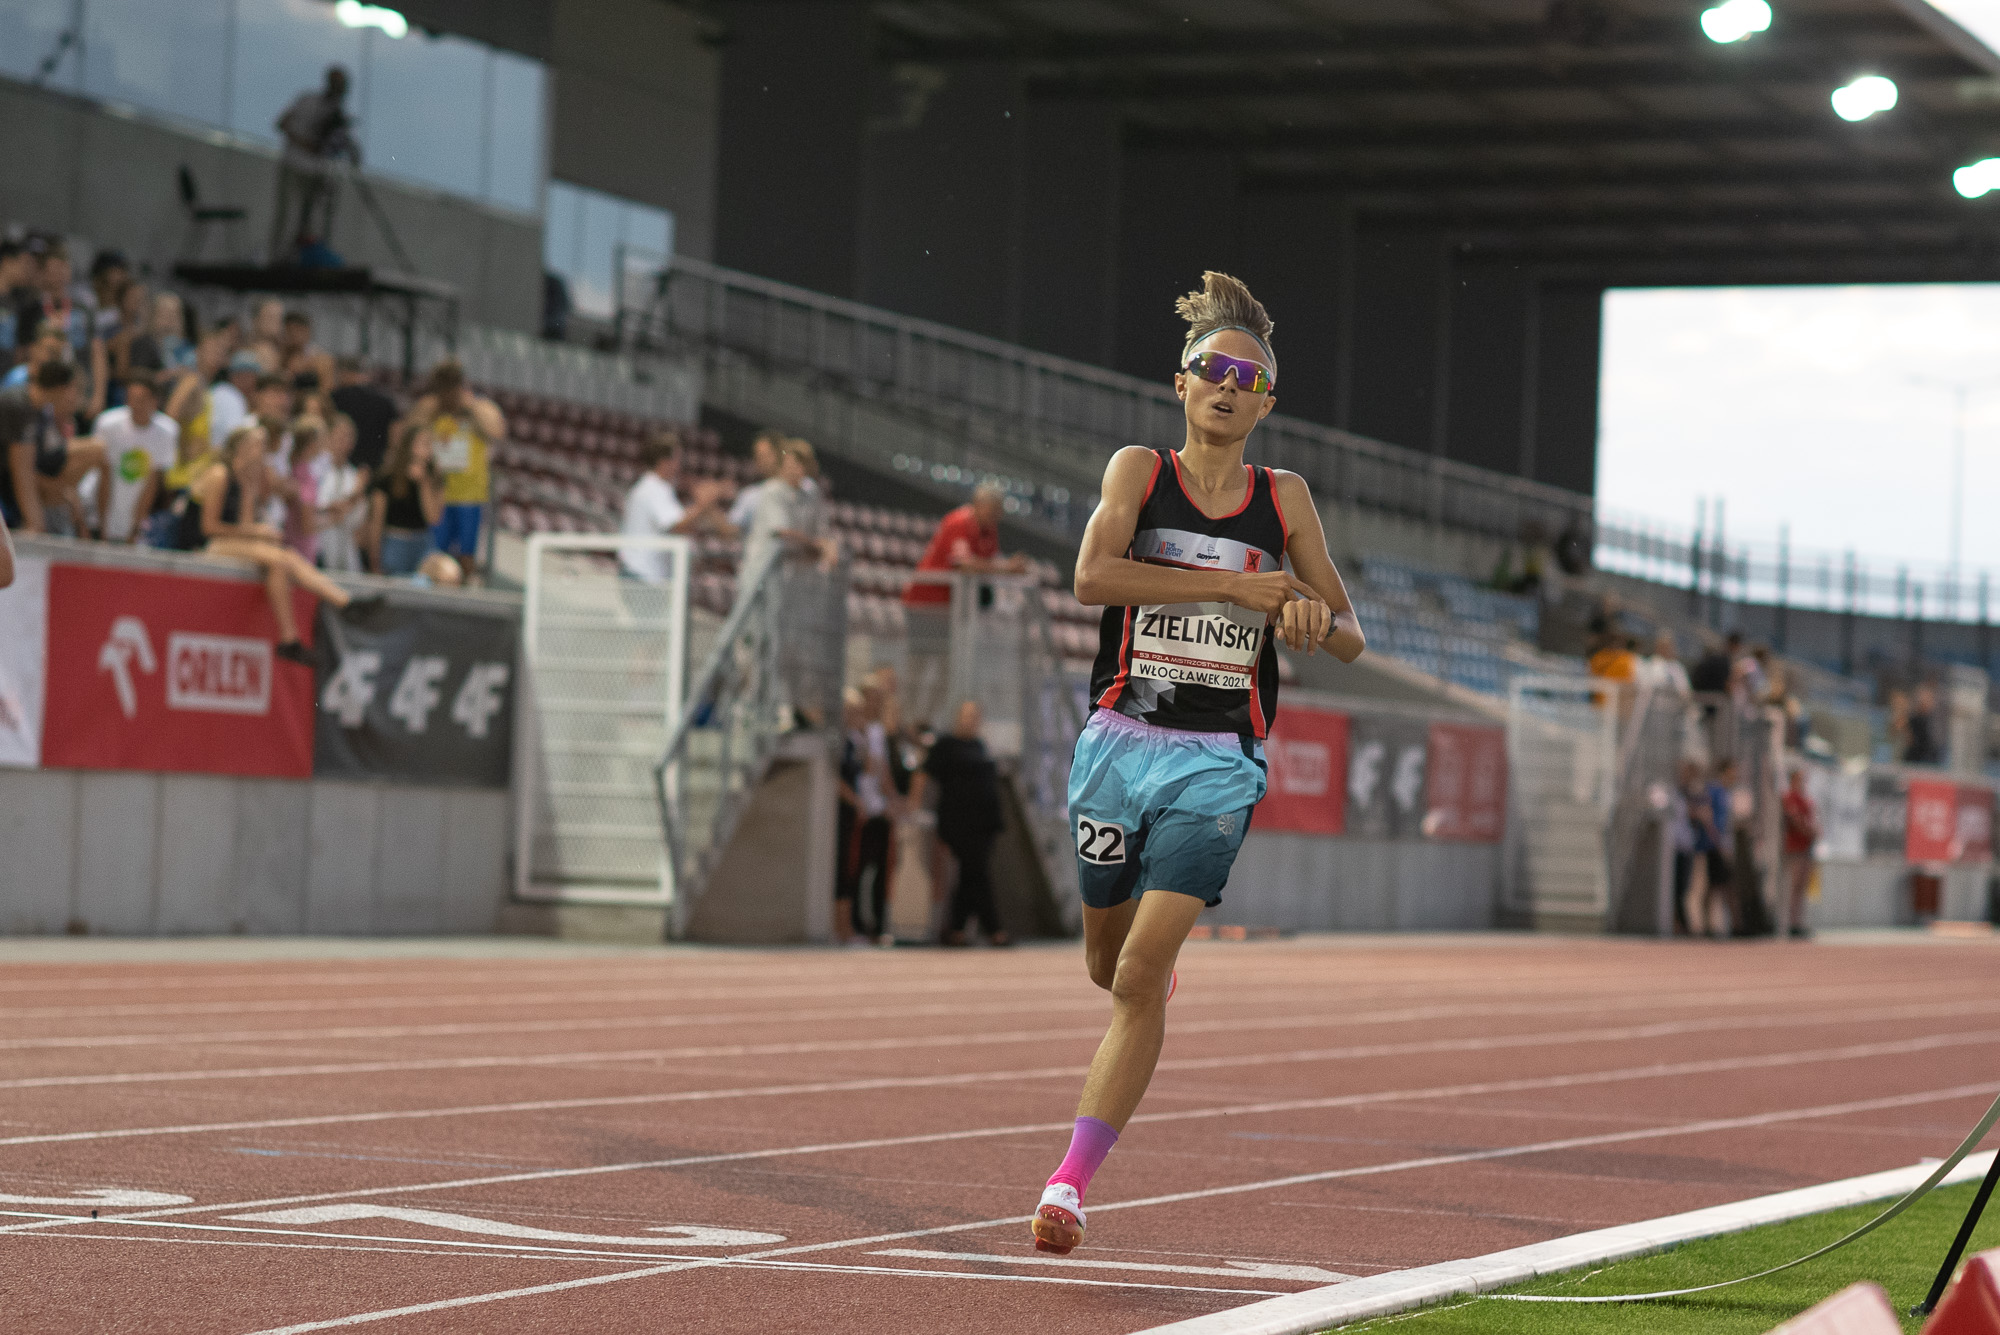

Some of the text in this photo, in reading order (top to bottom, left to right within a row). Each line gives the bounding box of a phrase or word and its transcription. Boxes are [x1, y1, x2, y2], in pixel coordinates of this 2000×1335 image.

[1141, 612, 1260, 652] ZIELIŃSKI
[1139, 663, 1246, 688] WŁOCŁAWEK 2021
[1152, 654, 1170, 662] PZLA
[1170, 657, 1220, 669] MISTRZOSTWA
[1220, 664, 1239, 672] POLSKI
[1079, 820, 1124, 862] 22
